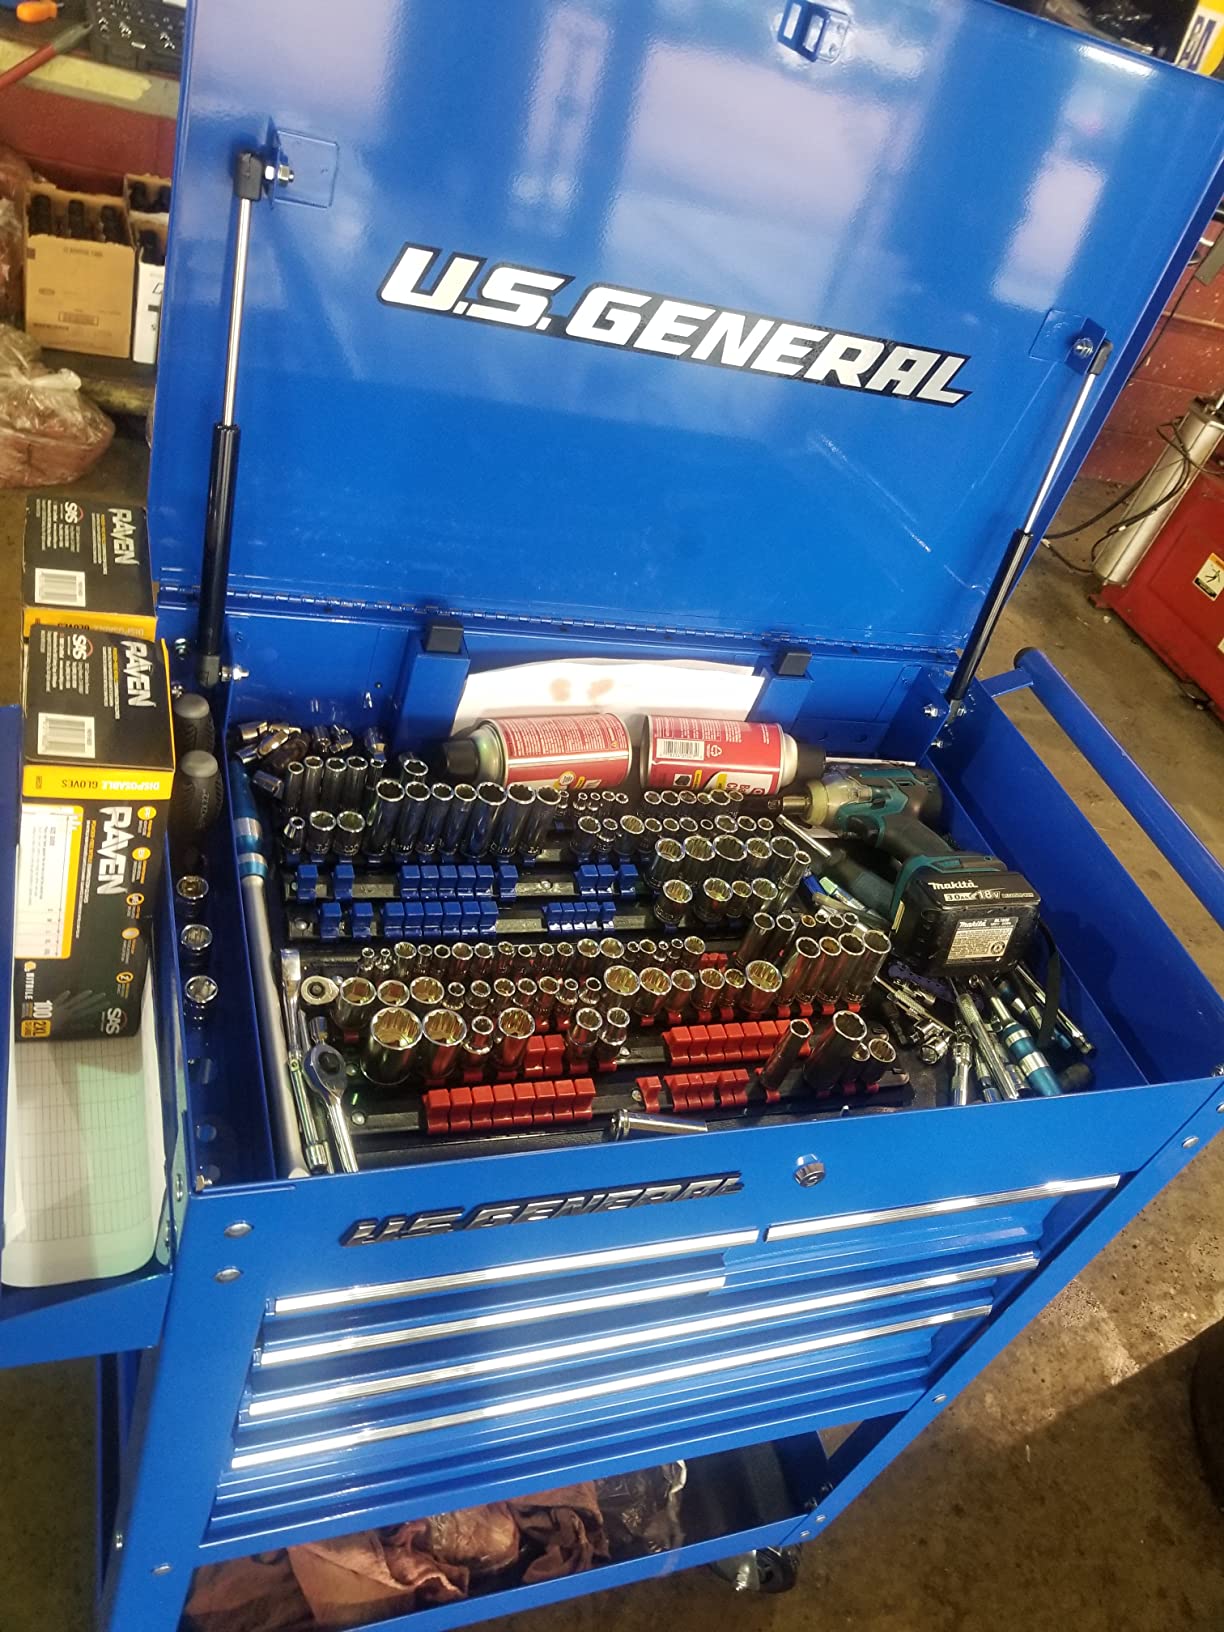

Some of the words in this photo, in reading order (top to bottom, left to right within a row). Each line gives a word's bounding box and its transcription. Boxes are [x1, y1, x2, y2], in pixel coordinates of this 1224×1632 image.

[565, 286, 971, 406] GENERAL
[65, 501, 79, 524] SAS
[109, 508, 140, 566] RAVEN
[72, 634, 87, 660] SAS
[121, 640, 157, 708] RAVEN
[62, 780, 98, 789] GLOVES
[97, 806, 133, 895] RAVEN
[33, 1000, 53, 1018] 100
[105, 1007, 121, 1035] SAS
[33, 1021, 47, 1036] 2XL
